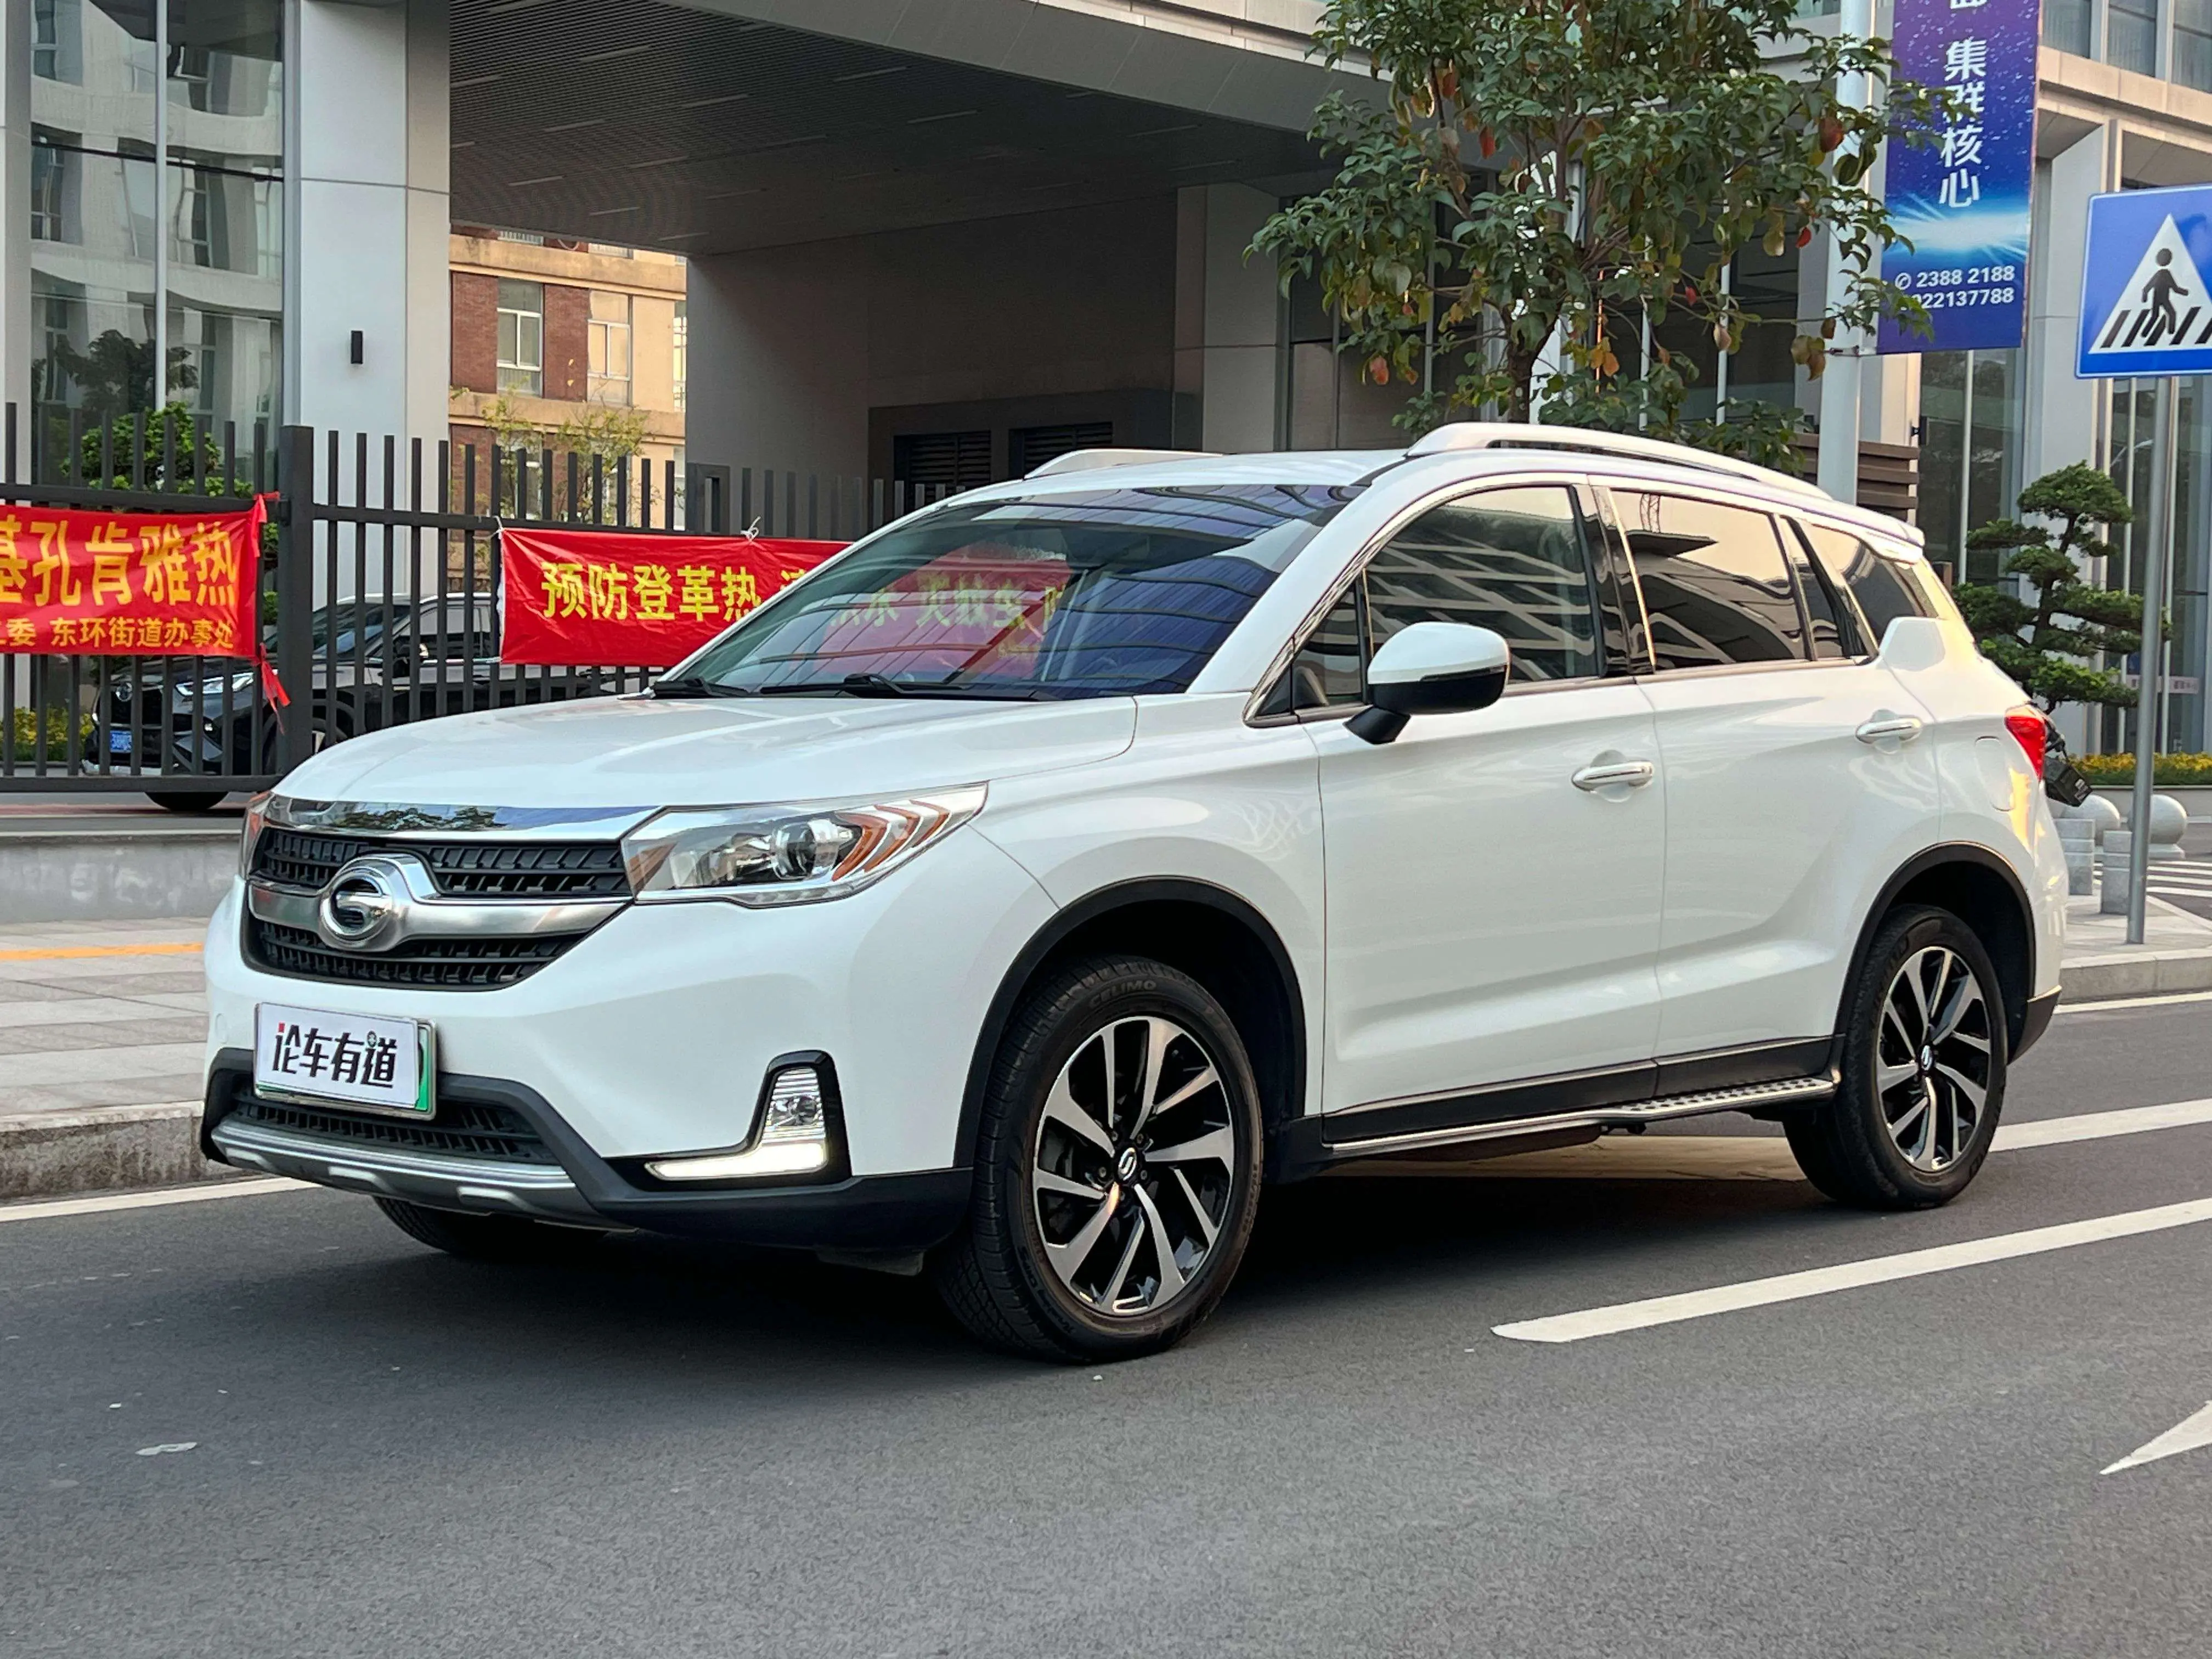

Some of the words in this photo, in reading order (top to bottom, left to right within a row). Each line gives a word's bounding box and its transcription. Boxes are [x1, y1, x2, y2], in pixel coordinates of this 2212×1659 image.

[1916, 269, 1962, 288] 2388
[1967, 265, 2015, 284] 2188
[1900, 287, 2015, 311] 22137788
[541, 561, 761, 622] 预防登革热
[0, 618, 37, 647] 委
[49, 616, 234, 649] 东环街道办事处
[272, 1022, 398, 1088] 论车有道
